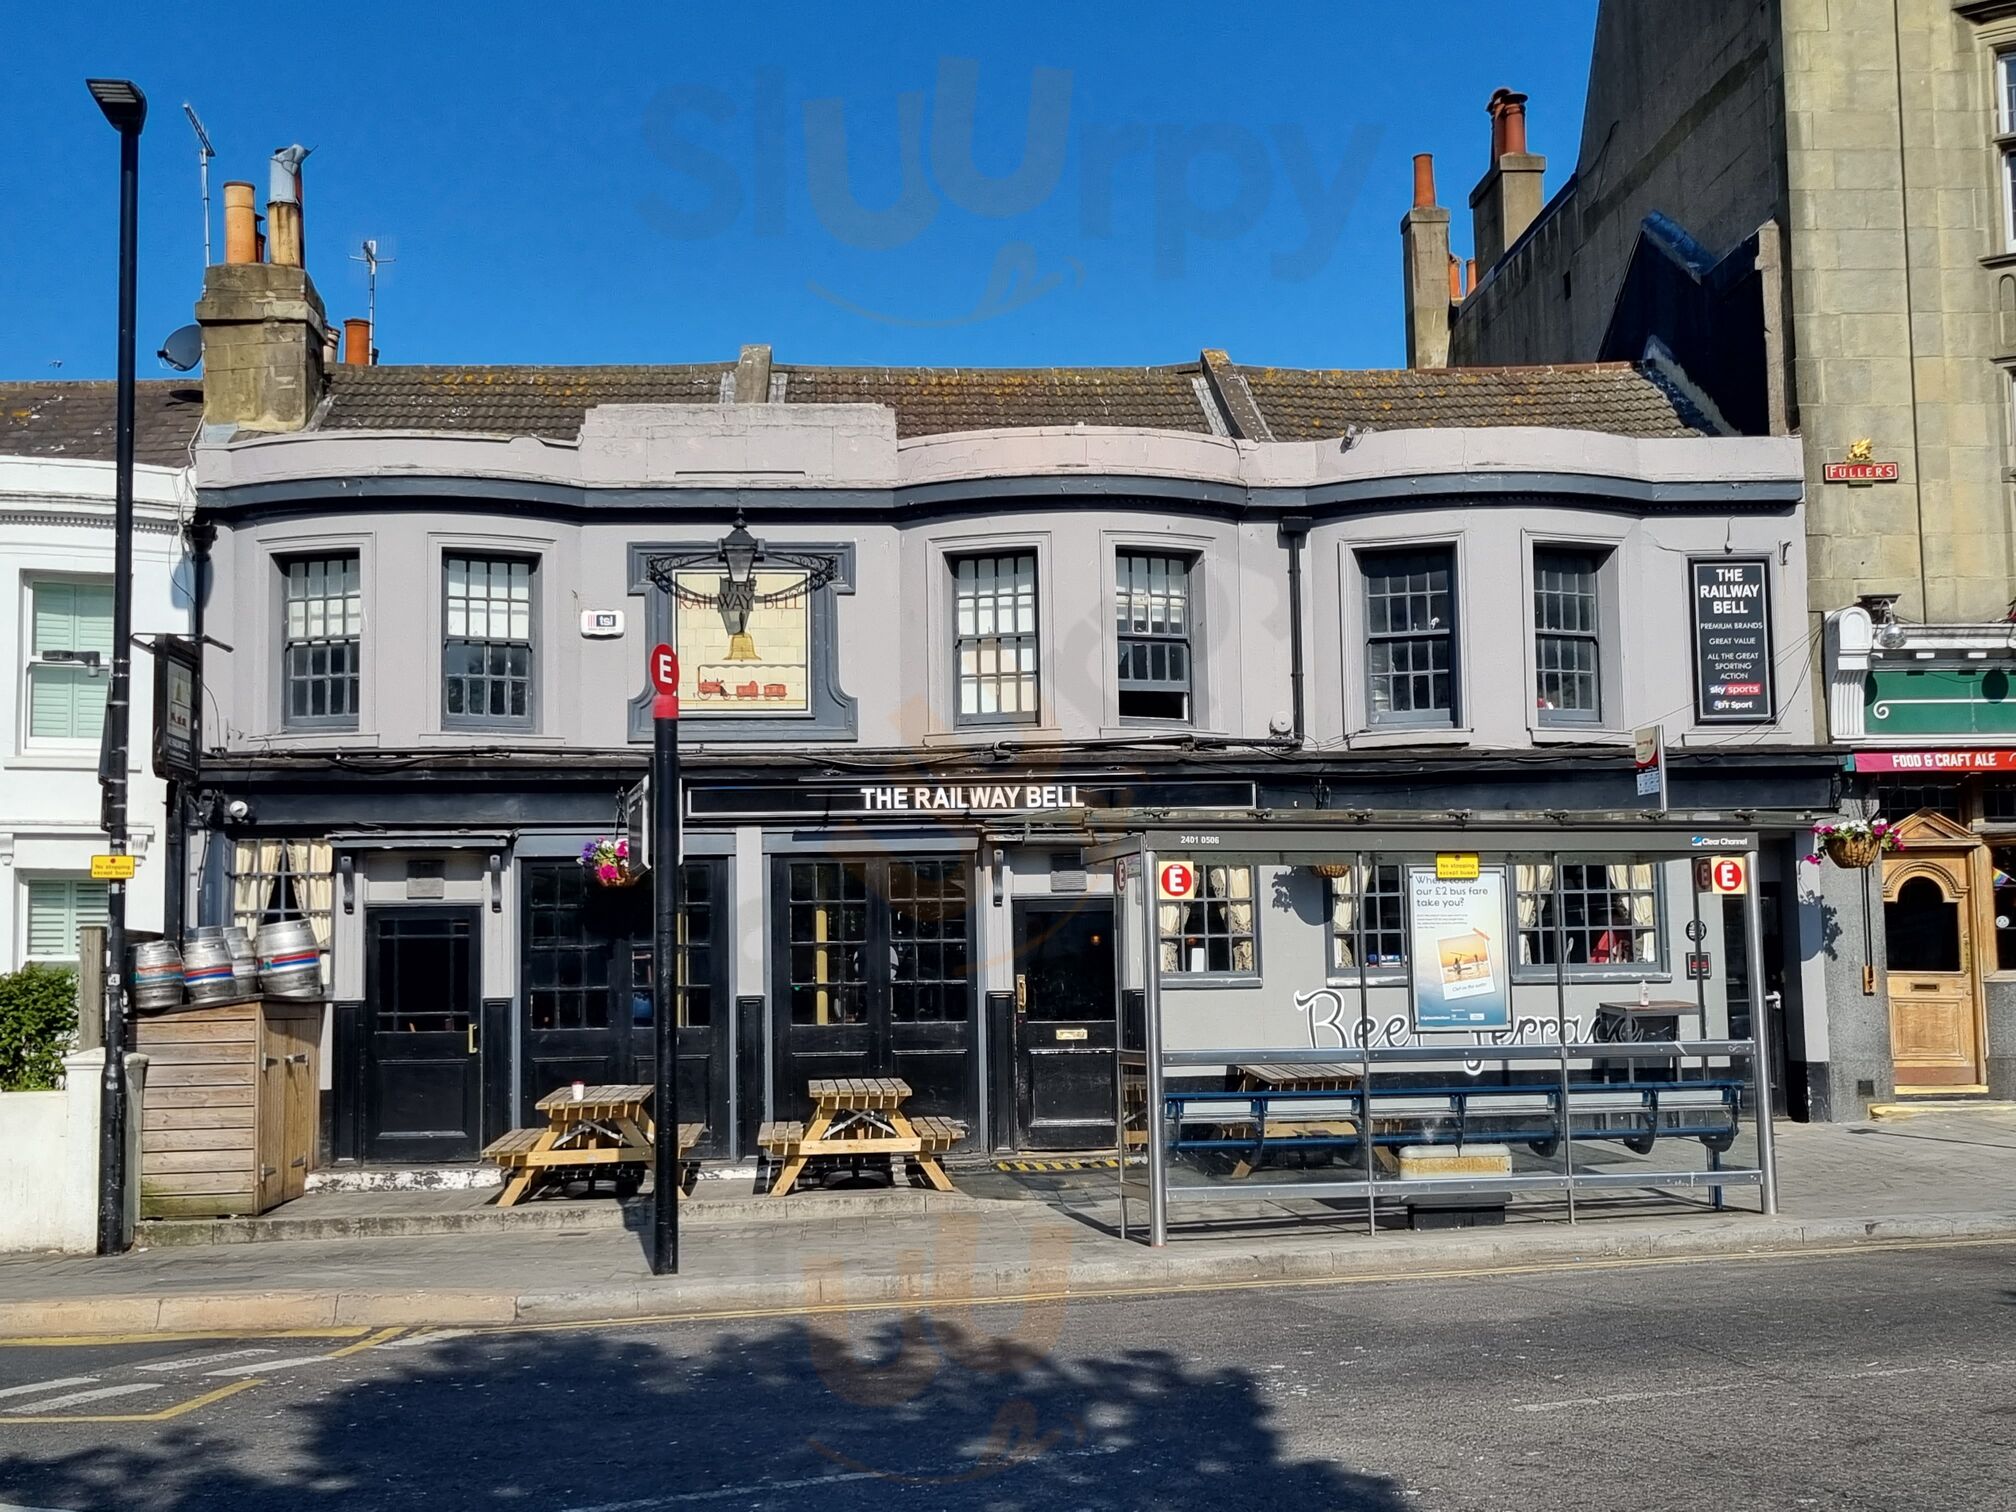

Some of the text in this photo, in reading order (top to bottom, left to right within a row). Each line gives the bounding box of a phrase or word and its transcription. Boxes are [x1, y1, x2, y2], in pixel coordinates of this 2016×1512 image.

[1829, 465, 1893, 478] FULLER'S
[1715, 568, 1744, 582] THE
[726, 579, 758, 592] THE
[1700, 584, 1760, 598] RAILWAY
[678, 593, 804, 610] RAILWAY BELL
[1713, 601, 1749, 614] BELL
[1700, 622, 1763, 630] PREMIUM BRANDS
[1735, 652, 1759, 660] GREAT
[659, 653, 673, 684] E
[1715, 662, 1752, 670] SPORTING
[1710, 685, 1759, 695] sky sports
[1731, 701, 1753, 710] Sport
[1892, 752, 1998, 768] FOOD & CRAFT ALE
[860, 786, 1085, 809] THE RAILWAY BELL
[1180, 836, 1220, 844] 2401 0506
[1702, 837, 1748, 846] Clear Channel
[1169, 868, 1184, 892] E
[1721, 864, 1736, 887] E
[1435, 886, 1448, 896] £2
[1449, 886, 1466, 896] bus
[1468, 886, 1488, 896] fare
[1416, 897, 1464, 908] take you?
